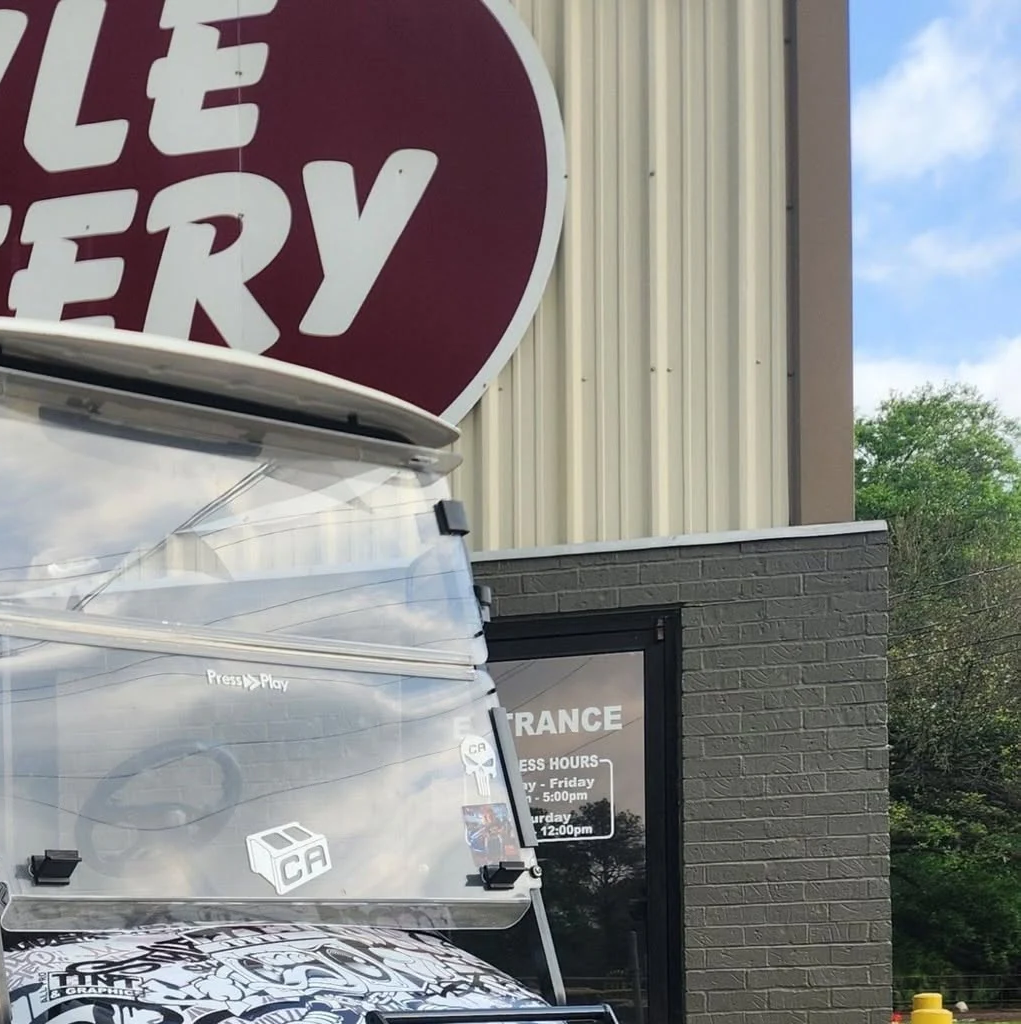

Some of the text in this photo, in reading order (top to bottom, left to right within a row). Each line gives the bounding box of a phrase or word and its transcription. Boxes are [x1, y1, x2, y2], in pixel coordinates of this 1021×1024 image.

[206, 669, 289, 692] Press Play
[549, 755, 599, 771] HOURS
[549, 777, 595, 790] Friday
[543, 790, 588, 803] 5:00pm
[540, 825, 593, 837] 12:00pm
[280, 845, 327, 886] CA
[51, 972, 141, 989] TINT
[49, 990, 61, 1000] &
